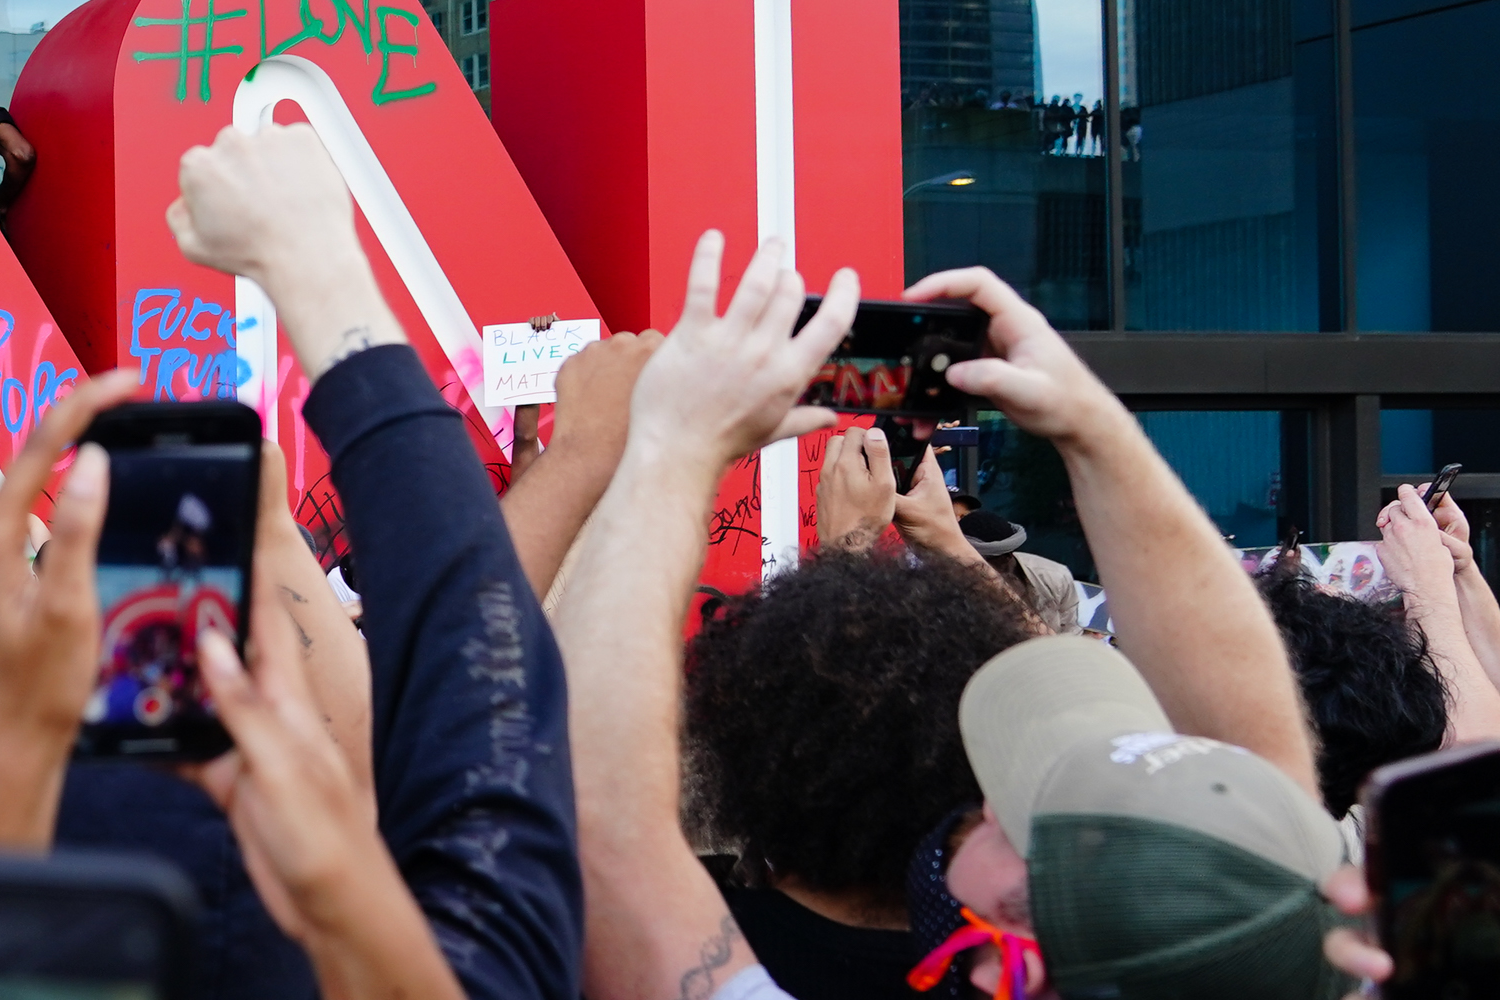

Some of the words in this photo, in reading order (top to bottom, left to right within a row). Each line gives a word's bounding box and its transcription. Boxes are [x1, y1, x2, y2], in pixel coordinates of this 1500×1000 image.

[131, 288, 257, 352] FUCK
[493, 325, 583, 347] BLACK
[502, 343, 580, 365] LIVES
